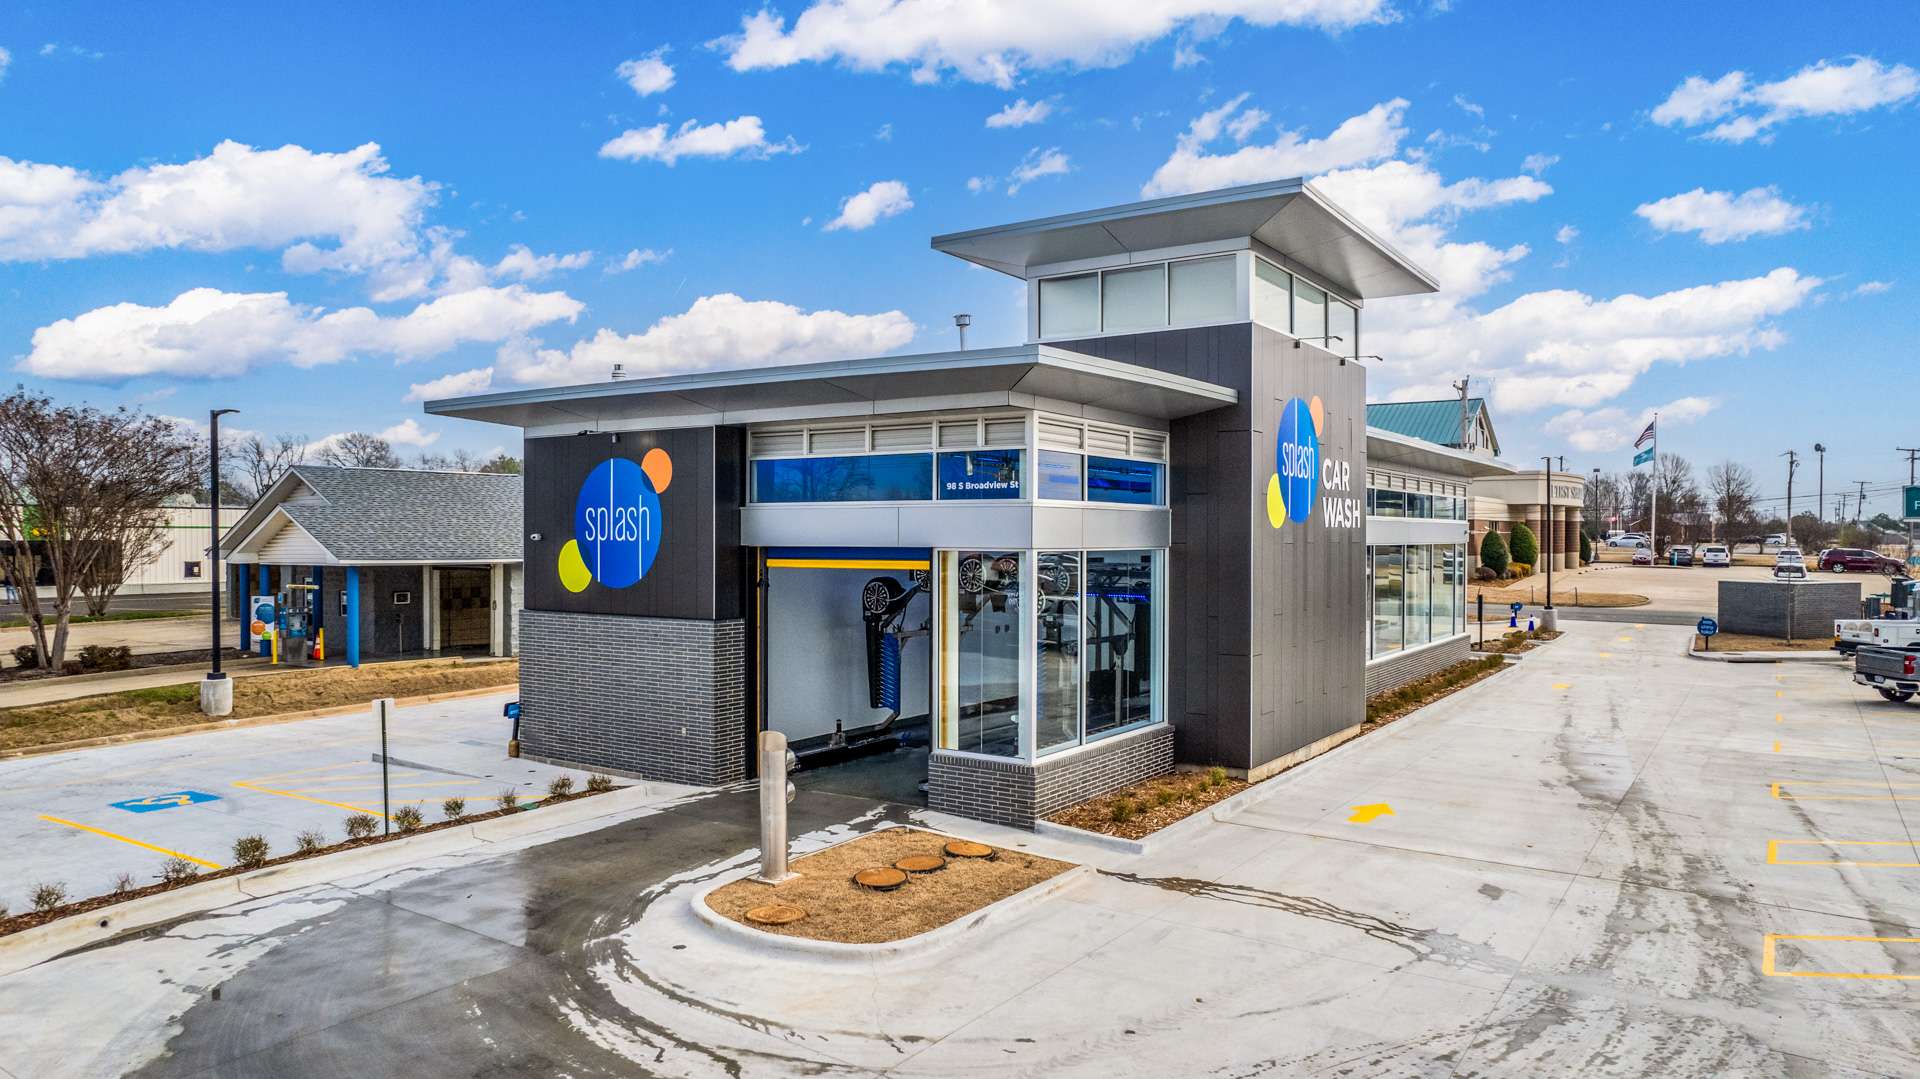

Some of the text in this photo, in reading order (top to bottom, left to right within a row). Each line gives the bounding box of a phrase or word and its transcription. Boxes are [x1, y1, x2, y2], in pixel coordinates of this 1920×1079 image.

[1282, 396, 1315, 518] splash
[946, 480, 1019, 490] 98 S Broadview St
[1322, 458, 1350, 491] CAR
[585, 458, 650, 582] splash
[1322, 497, 1361, 528] WASH
